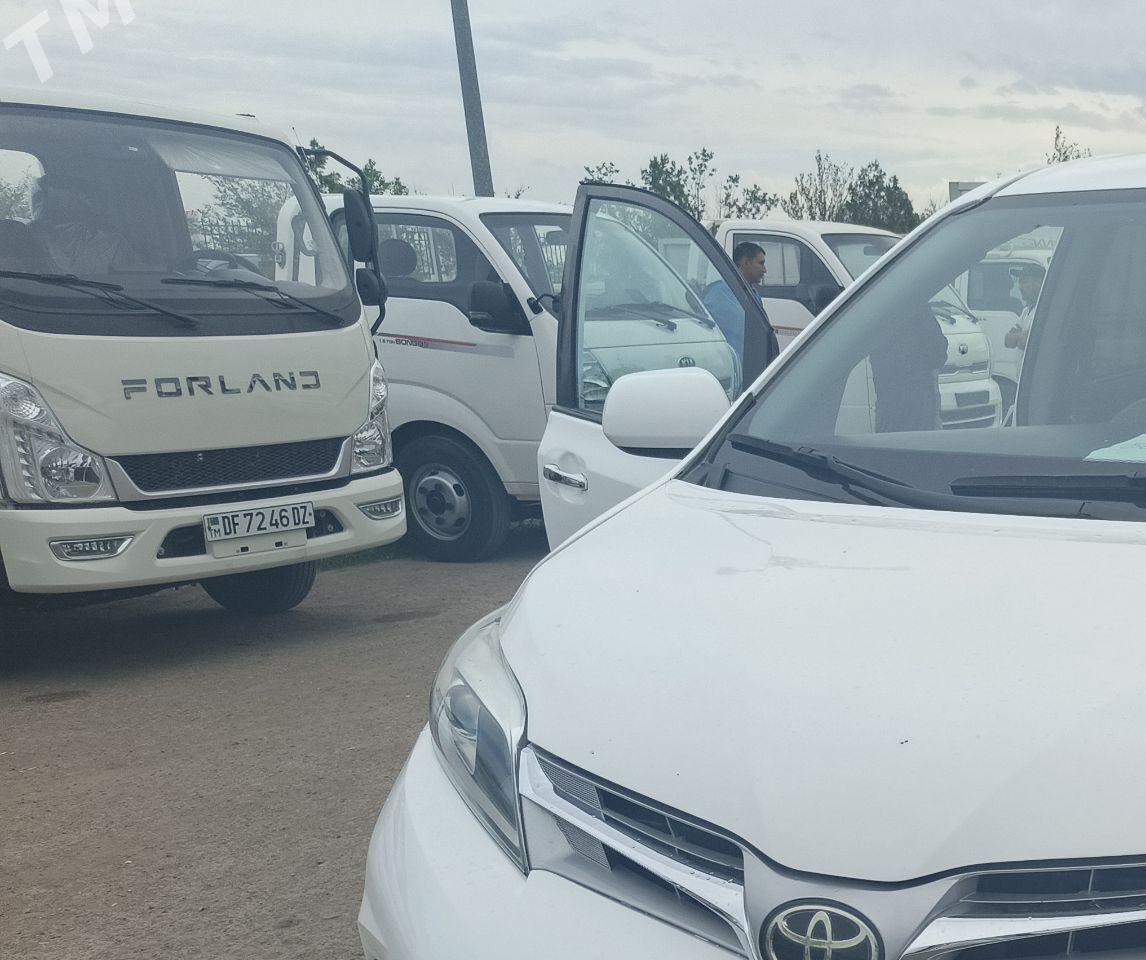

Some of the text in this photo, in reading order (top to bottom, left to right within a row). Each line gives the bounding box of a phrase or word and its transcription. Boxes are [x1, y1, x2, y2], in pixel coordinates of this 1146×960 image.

[121, 371, 321, 400] FORLAND
[209, 528, 220, 538] TM
[221, 506, 309, 536] DF 7246 DZ
